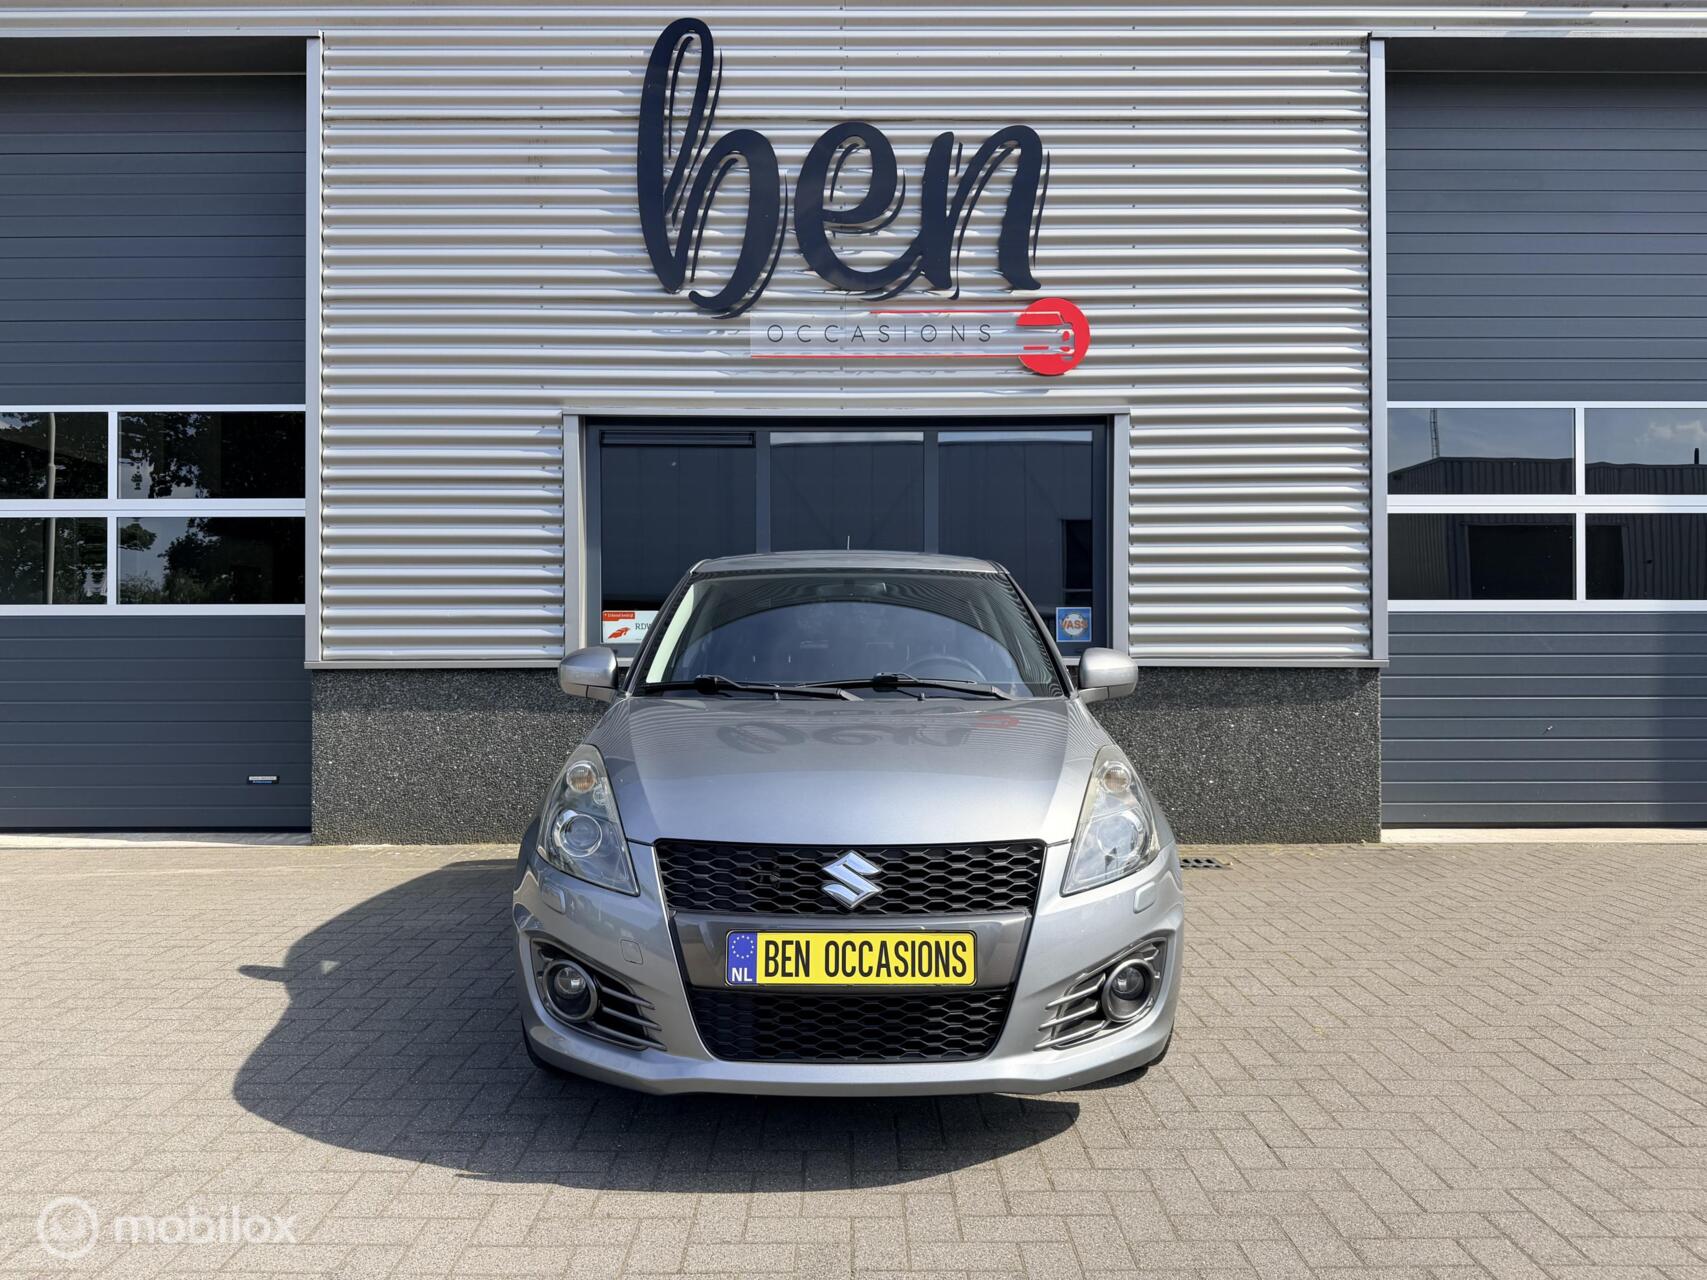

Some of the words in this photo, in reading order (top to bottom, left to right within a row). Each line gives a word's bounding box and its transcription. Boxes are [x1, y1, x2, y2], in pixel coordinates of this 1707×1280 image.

[637, 17, 1050, 319] ben
[767, 324, 992, 344] OCCASIONS
[764, 940, 811, 978] BEN
[824, 940, 967, 978] OCCASIONS
[731, 967, 753, 982] NL
